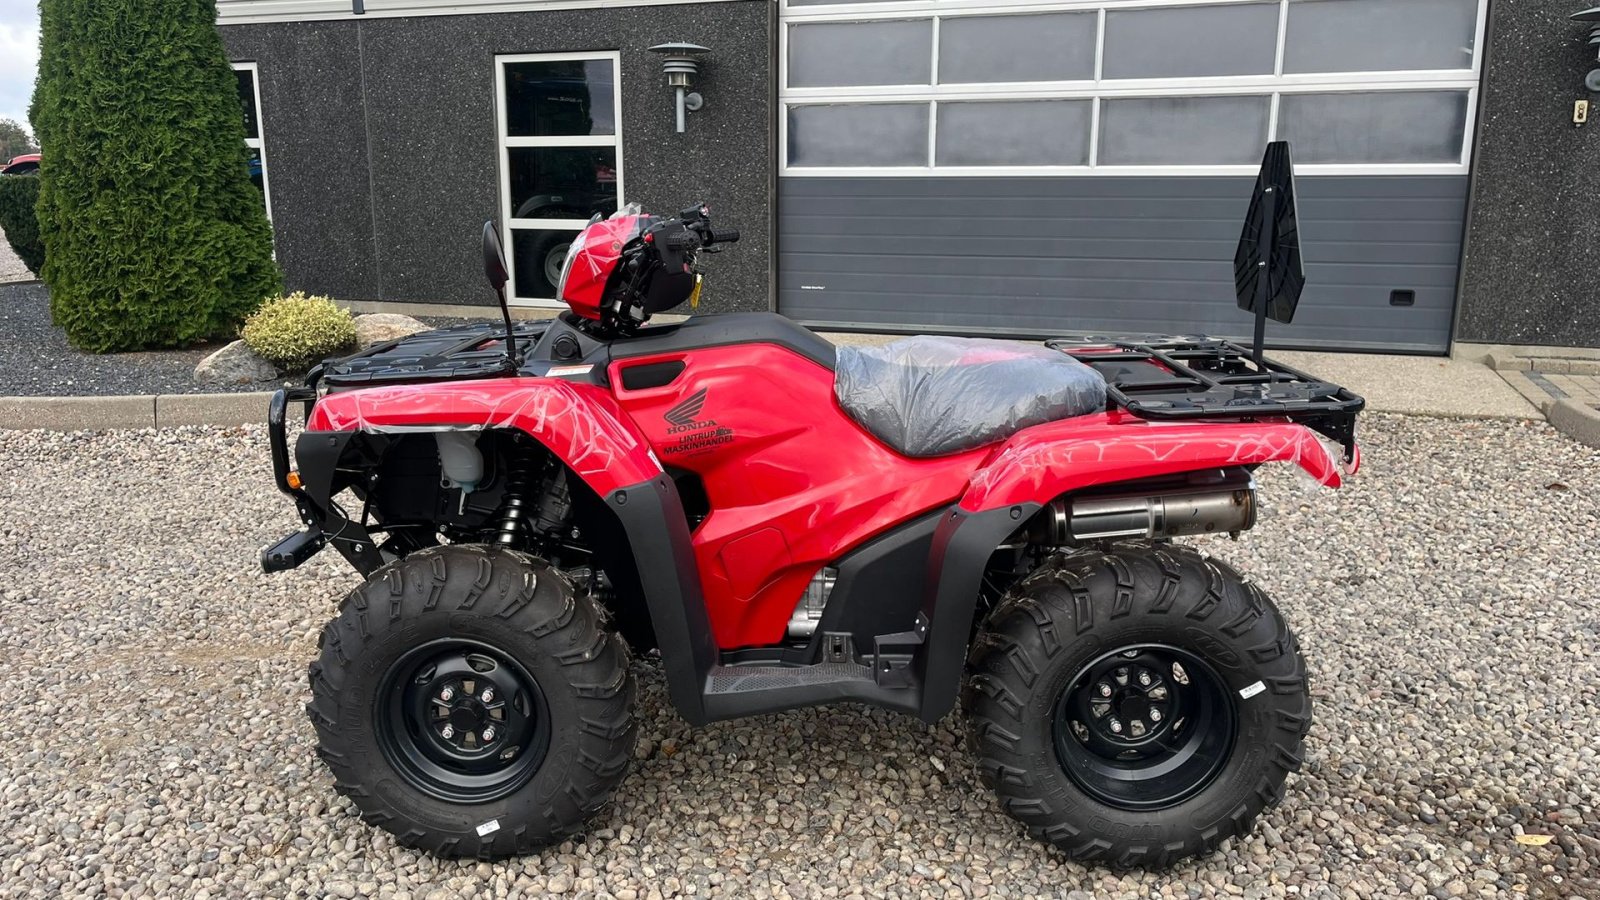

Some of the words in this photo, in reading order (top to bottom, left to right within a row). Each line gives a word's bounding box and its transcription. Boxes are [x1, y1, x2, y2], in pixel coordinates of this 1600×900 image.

[667, 420, 717, 434] HONDA
[680, 430, 716, 443] LINTRUP
[664, 435, 734, 454] MASKINHANDEL
